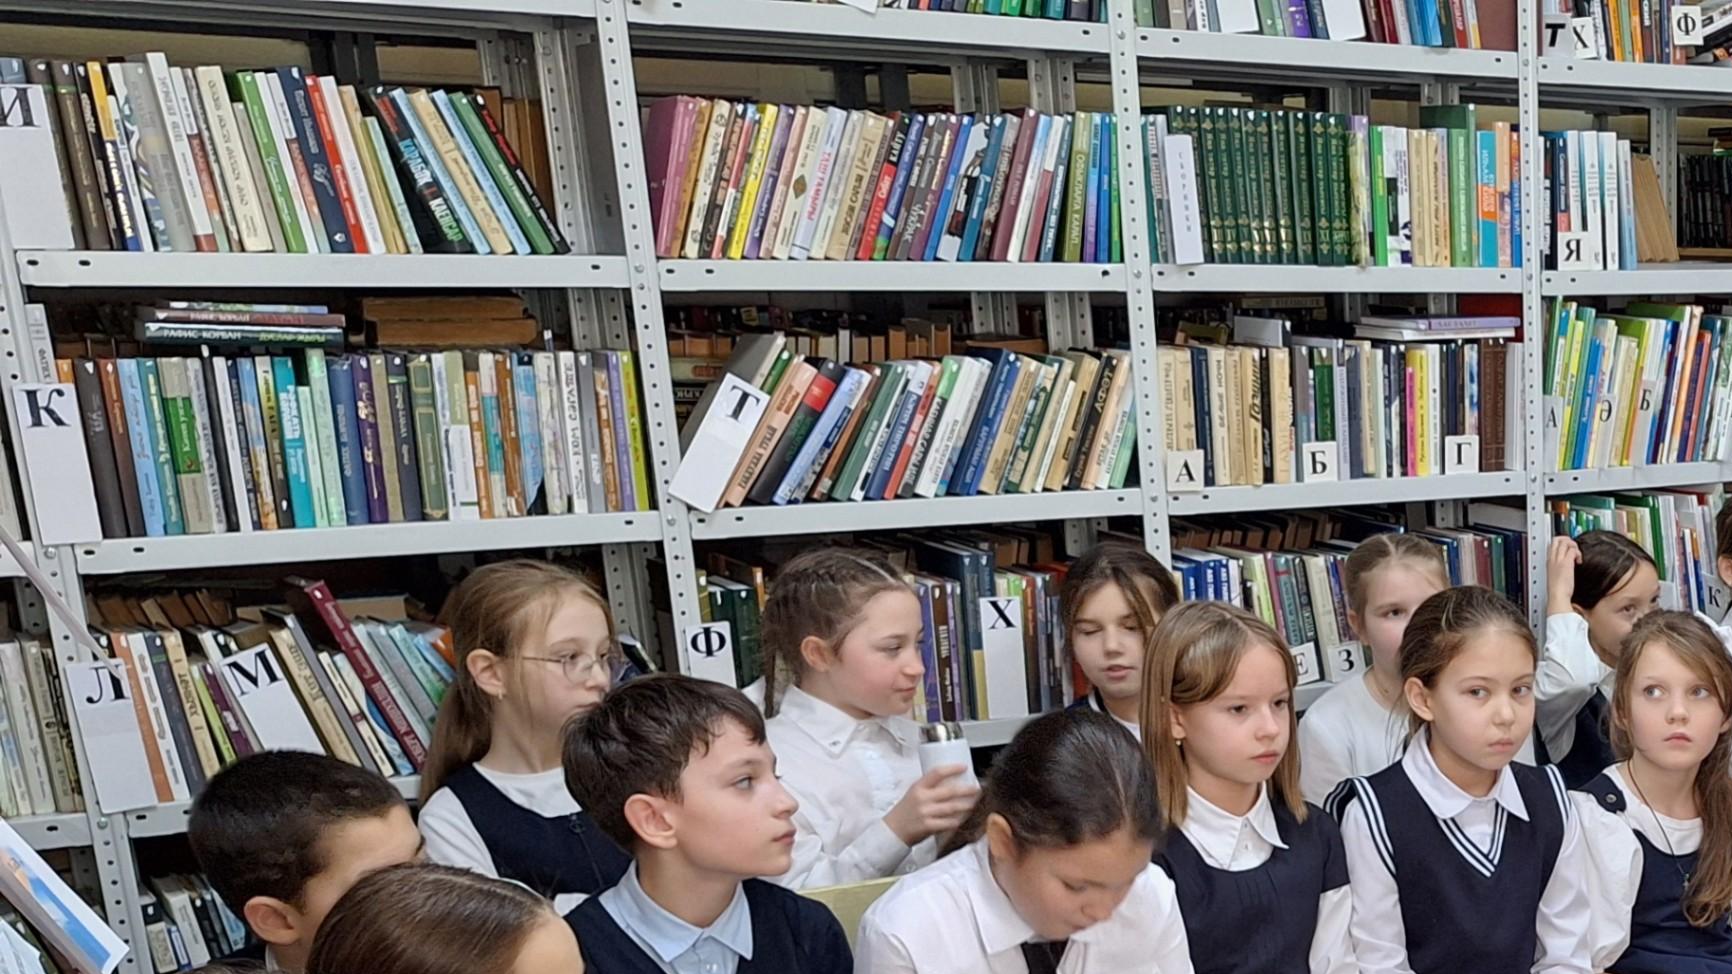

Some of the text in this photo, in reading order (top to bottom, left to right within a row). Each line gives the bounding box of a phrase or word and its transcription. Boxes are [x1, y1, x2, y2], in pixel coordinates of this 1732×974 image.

[1545, 23, 1566, 46] Т
[1678, 13, 1696, 36] Ф
[1573, 27, 1591, 49] Х
[1563, 236, 1583, 262] Я
[26, 388, 70, 428] К
[727, 384, 770, 423] Т
[1639, 390, 1651, 411] Б
[1545, 406, 1557, 429] А
[1310, 451, 1328, 475] Б
[1454, 442, 1472, 465] Г
[1175, 459, 1196, 483] А
[1708, 585, 1721, 608] К
[987, 598, 1017, 630] Х
[689, 626, 728, 657] Ф
[223, 648, 284, 697] М
[1338, 648, 1356, 673] З
[86, 665, 130, 704] Л
